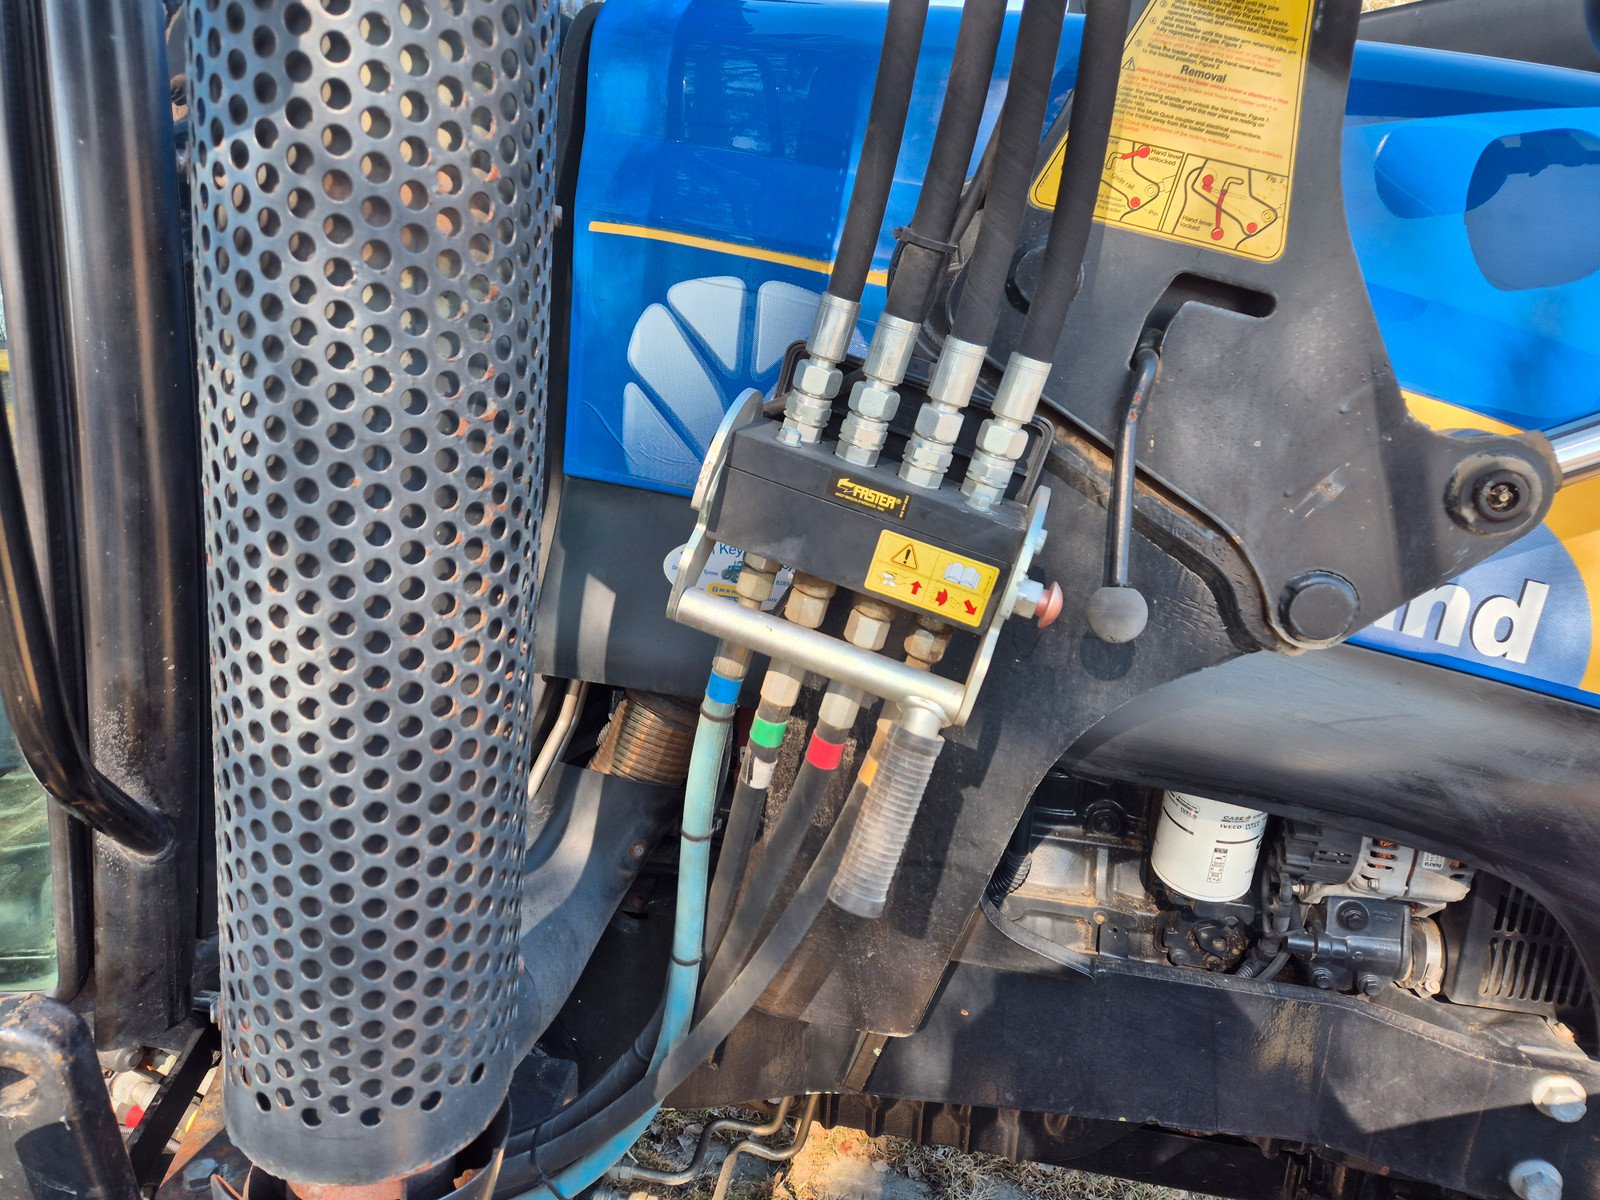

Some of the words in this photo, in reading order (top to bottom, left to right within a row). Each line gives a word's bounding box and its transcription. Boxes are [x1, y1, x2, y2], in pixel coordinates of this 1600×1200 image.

[1196, 2, 1215, 10] tractor
[1225, 9, 1242, 17] apply
[1250, 14, 1272, 24] parking
[1242, 6, 1260, 15] Figure
[1170, 2, 1190, 11] Relieve
[1189, 7, 1214, 18] hydraulic
[1214, 12, 1234, 22] system
[1234, 18, 1257, 27] pressure
[1270, 25, 1289, 33] tractor
[1166, 8, 1192, 19] operators
[1224, 21, 1246, 30] connect
[1276, 33, 1298, 43] coupler
[1167, 28, 1194, 39] registered
[1220, 40, 1238, 49] Figure
[1251, 40, 1275, 51] retaining
[1157, 51, 1175, 59] locked
[1174, 55, 1198, 65] position,
[1197, 60, 1215, 69] Figure
[1179, 64, 1227, 83] Removal
[1251, 66, 1281, 77] downwards
[1143, 90, 1163, 99] parking
[1163, 94, 1181, 102] stands
[1247, 113, 1265, 122] Figure
[1134, 112, 1152, 120] tractor
[1238, 117, 1257, 126] resting
[1174, 115, 1195, 124] coupler
[1205, 122, 1229, 131] electrical
[1148, 155, 1176, 166] unlocked
[1150, 148, 1166, 156] Hand
[1166, 151, 1182, 160] lever
[1179, 221, 1200, 231] locked
[1180, 214, 1198, 223] Hand
[1198, 218, 1214, 227] lever
